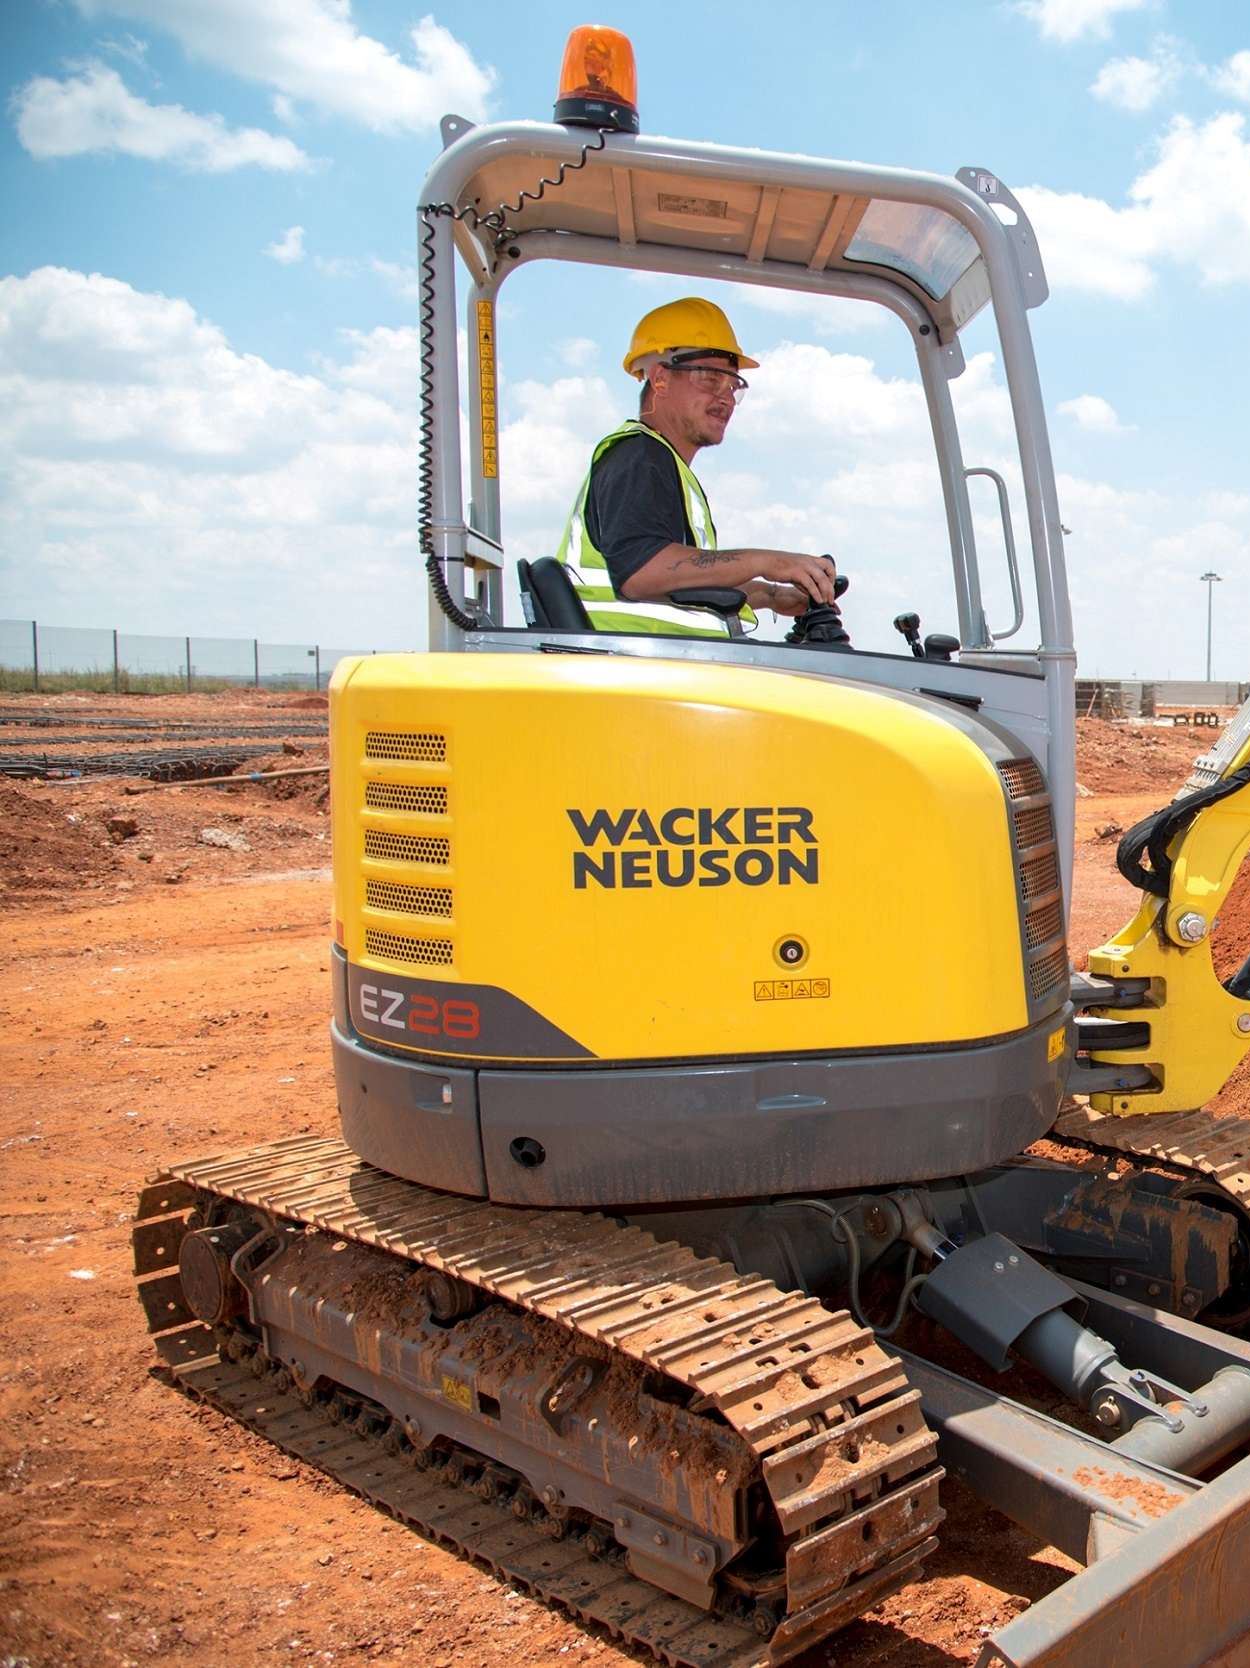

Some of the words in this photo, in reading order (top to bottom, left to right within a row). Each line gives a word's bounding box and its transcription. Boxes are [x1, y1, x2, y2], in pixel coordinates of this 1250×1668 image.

[566, 807, 818, 846] WACKER
[573, 848, 818, 889] NEUSON
[360, 984, 480, 1039] EZ28
